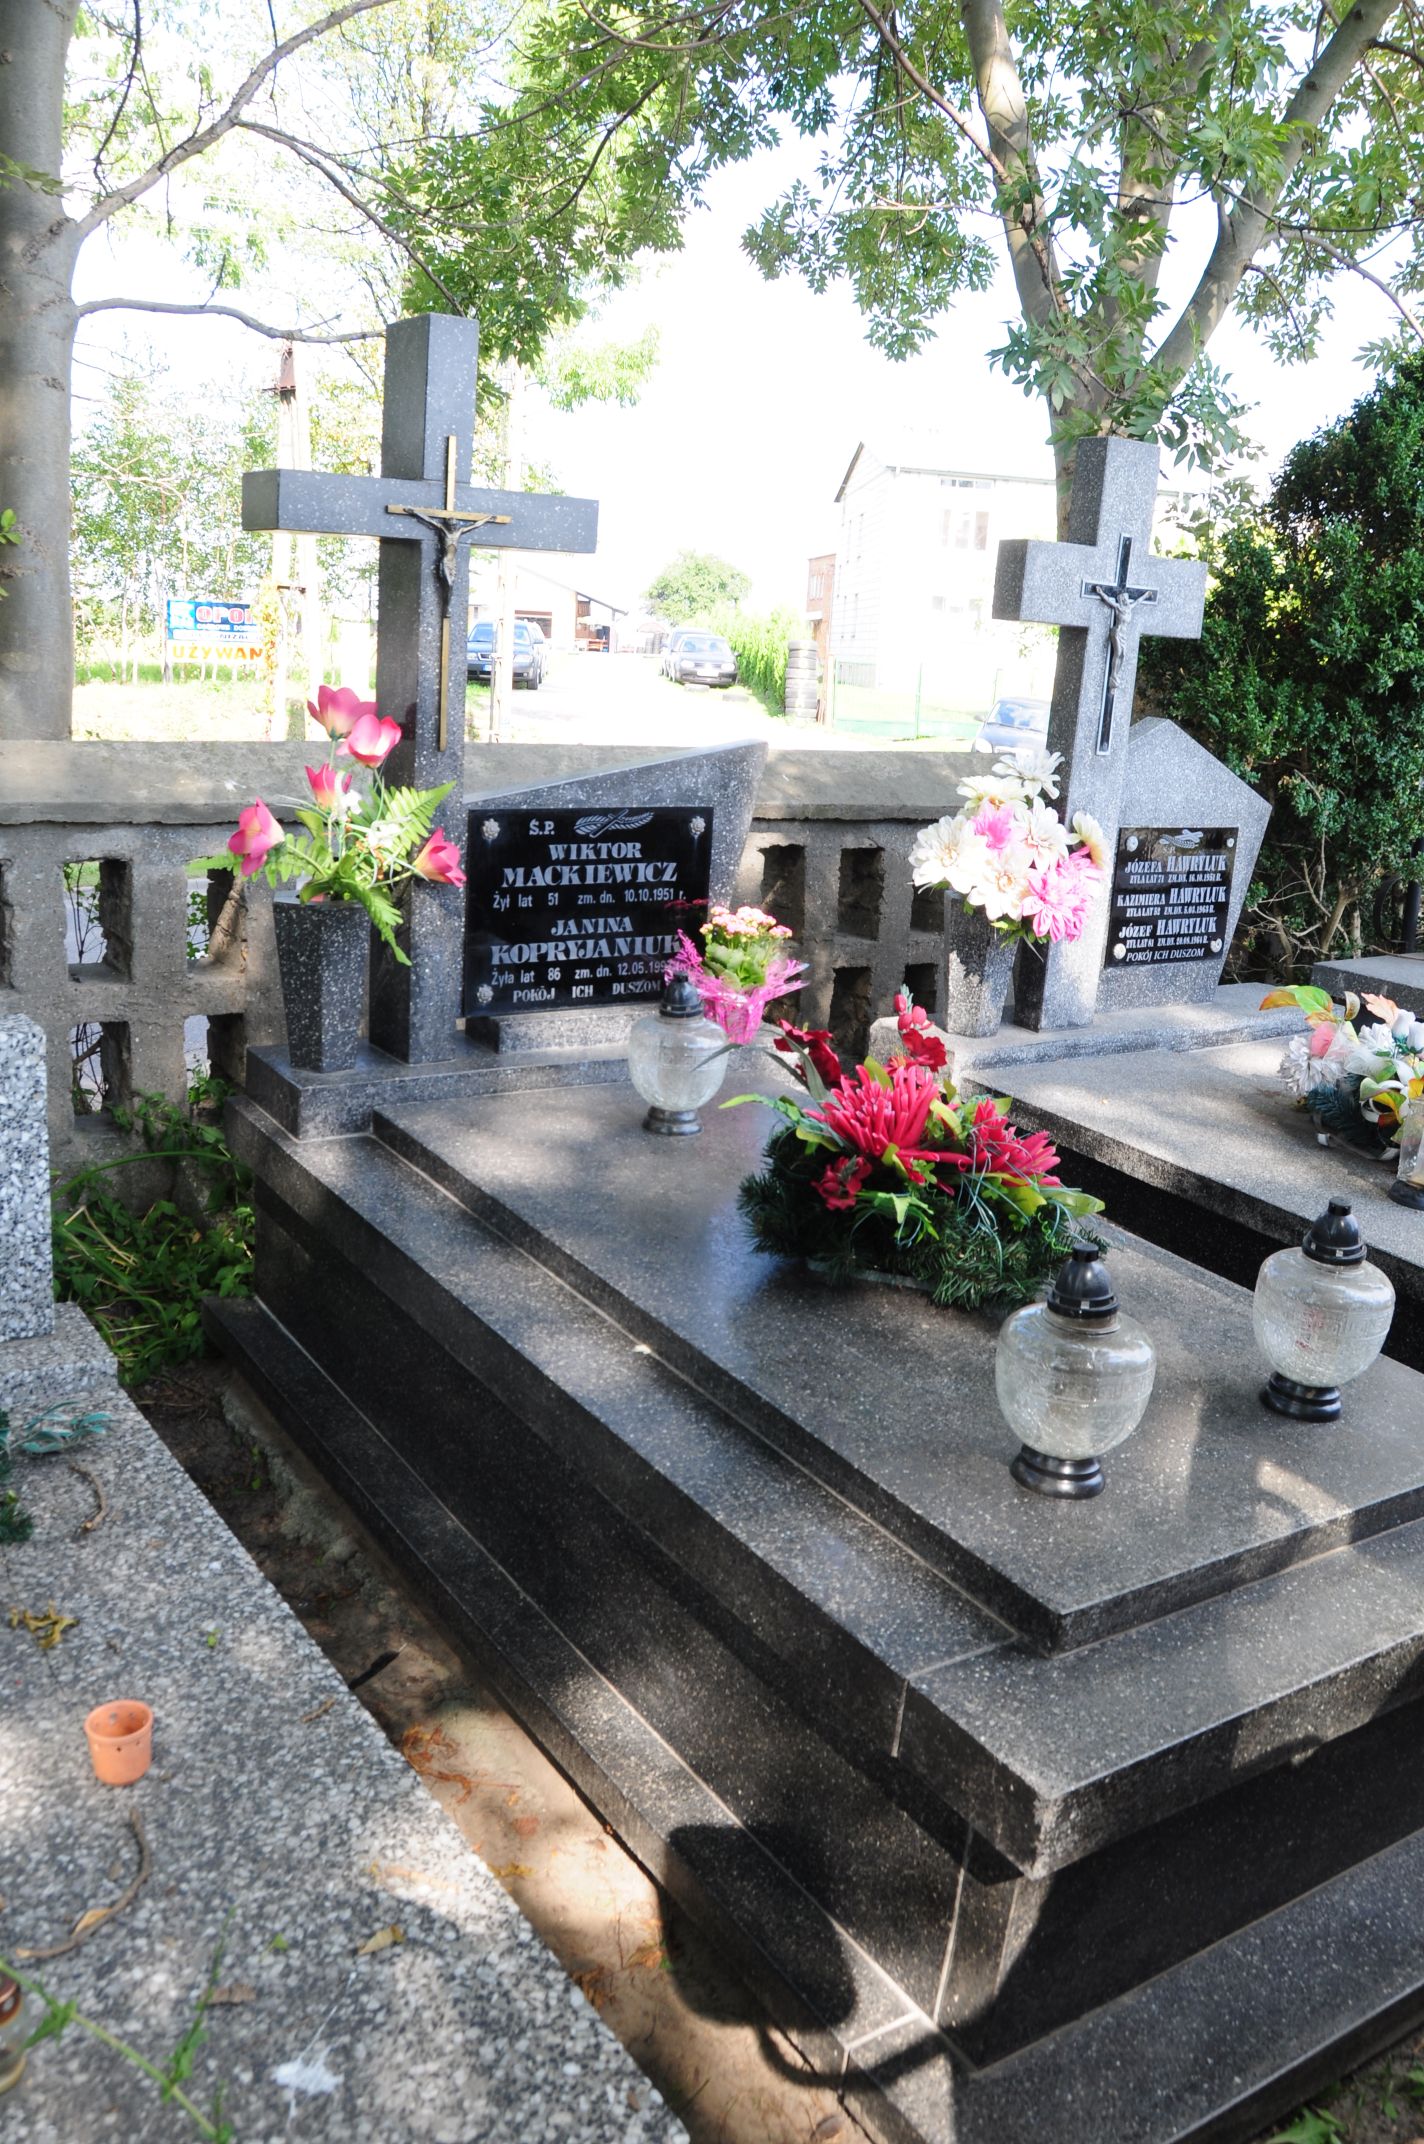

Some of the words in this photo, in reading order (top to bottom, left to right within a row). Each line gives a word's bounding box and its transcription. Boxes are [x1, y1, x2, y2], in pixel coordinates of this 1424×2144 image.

[529, 818, 556, 836] Ś.P.
[548, 841, 643, 862] WIKTOR
[500, 861, 679, 888] MACKIEWICZ
[1124, 858, 1162, 874] JÓZEFA
[518, 893, 533, 909] lat
[547, 892, 560, 906] 51
[577, 892, 597, 906] zm.
[600, 890, 616, 905] dn.
[624, 887, 675, 903] 10.10.1951
[1117, 893, 1166, 907] KAZIMIERA
[550, 916, 635, 937] JANINA
[1118, 922, 1153, 939] JÓZEF
[490, 934, 682, 966] KOPRYJANIUK
[1125, 949, 1152, 963] POKÓJ
[1153, 950, 1169, 960] ICH
[1169, 947, 1205, 959] DUSZOM
[520, 968, 535, 983] lat
[547, 967, 561, 981] 86
[574, 969, 594, 980] zm.
[596, 965, 612, 979] dn.
[617, 960, 672, 976] 12.05.199
[512, 985, 556, 1004] POKÓJ
[571, 985, 595, 999] ICH
[611, 979, 662, 996] DUSZOM
